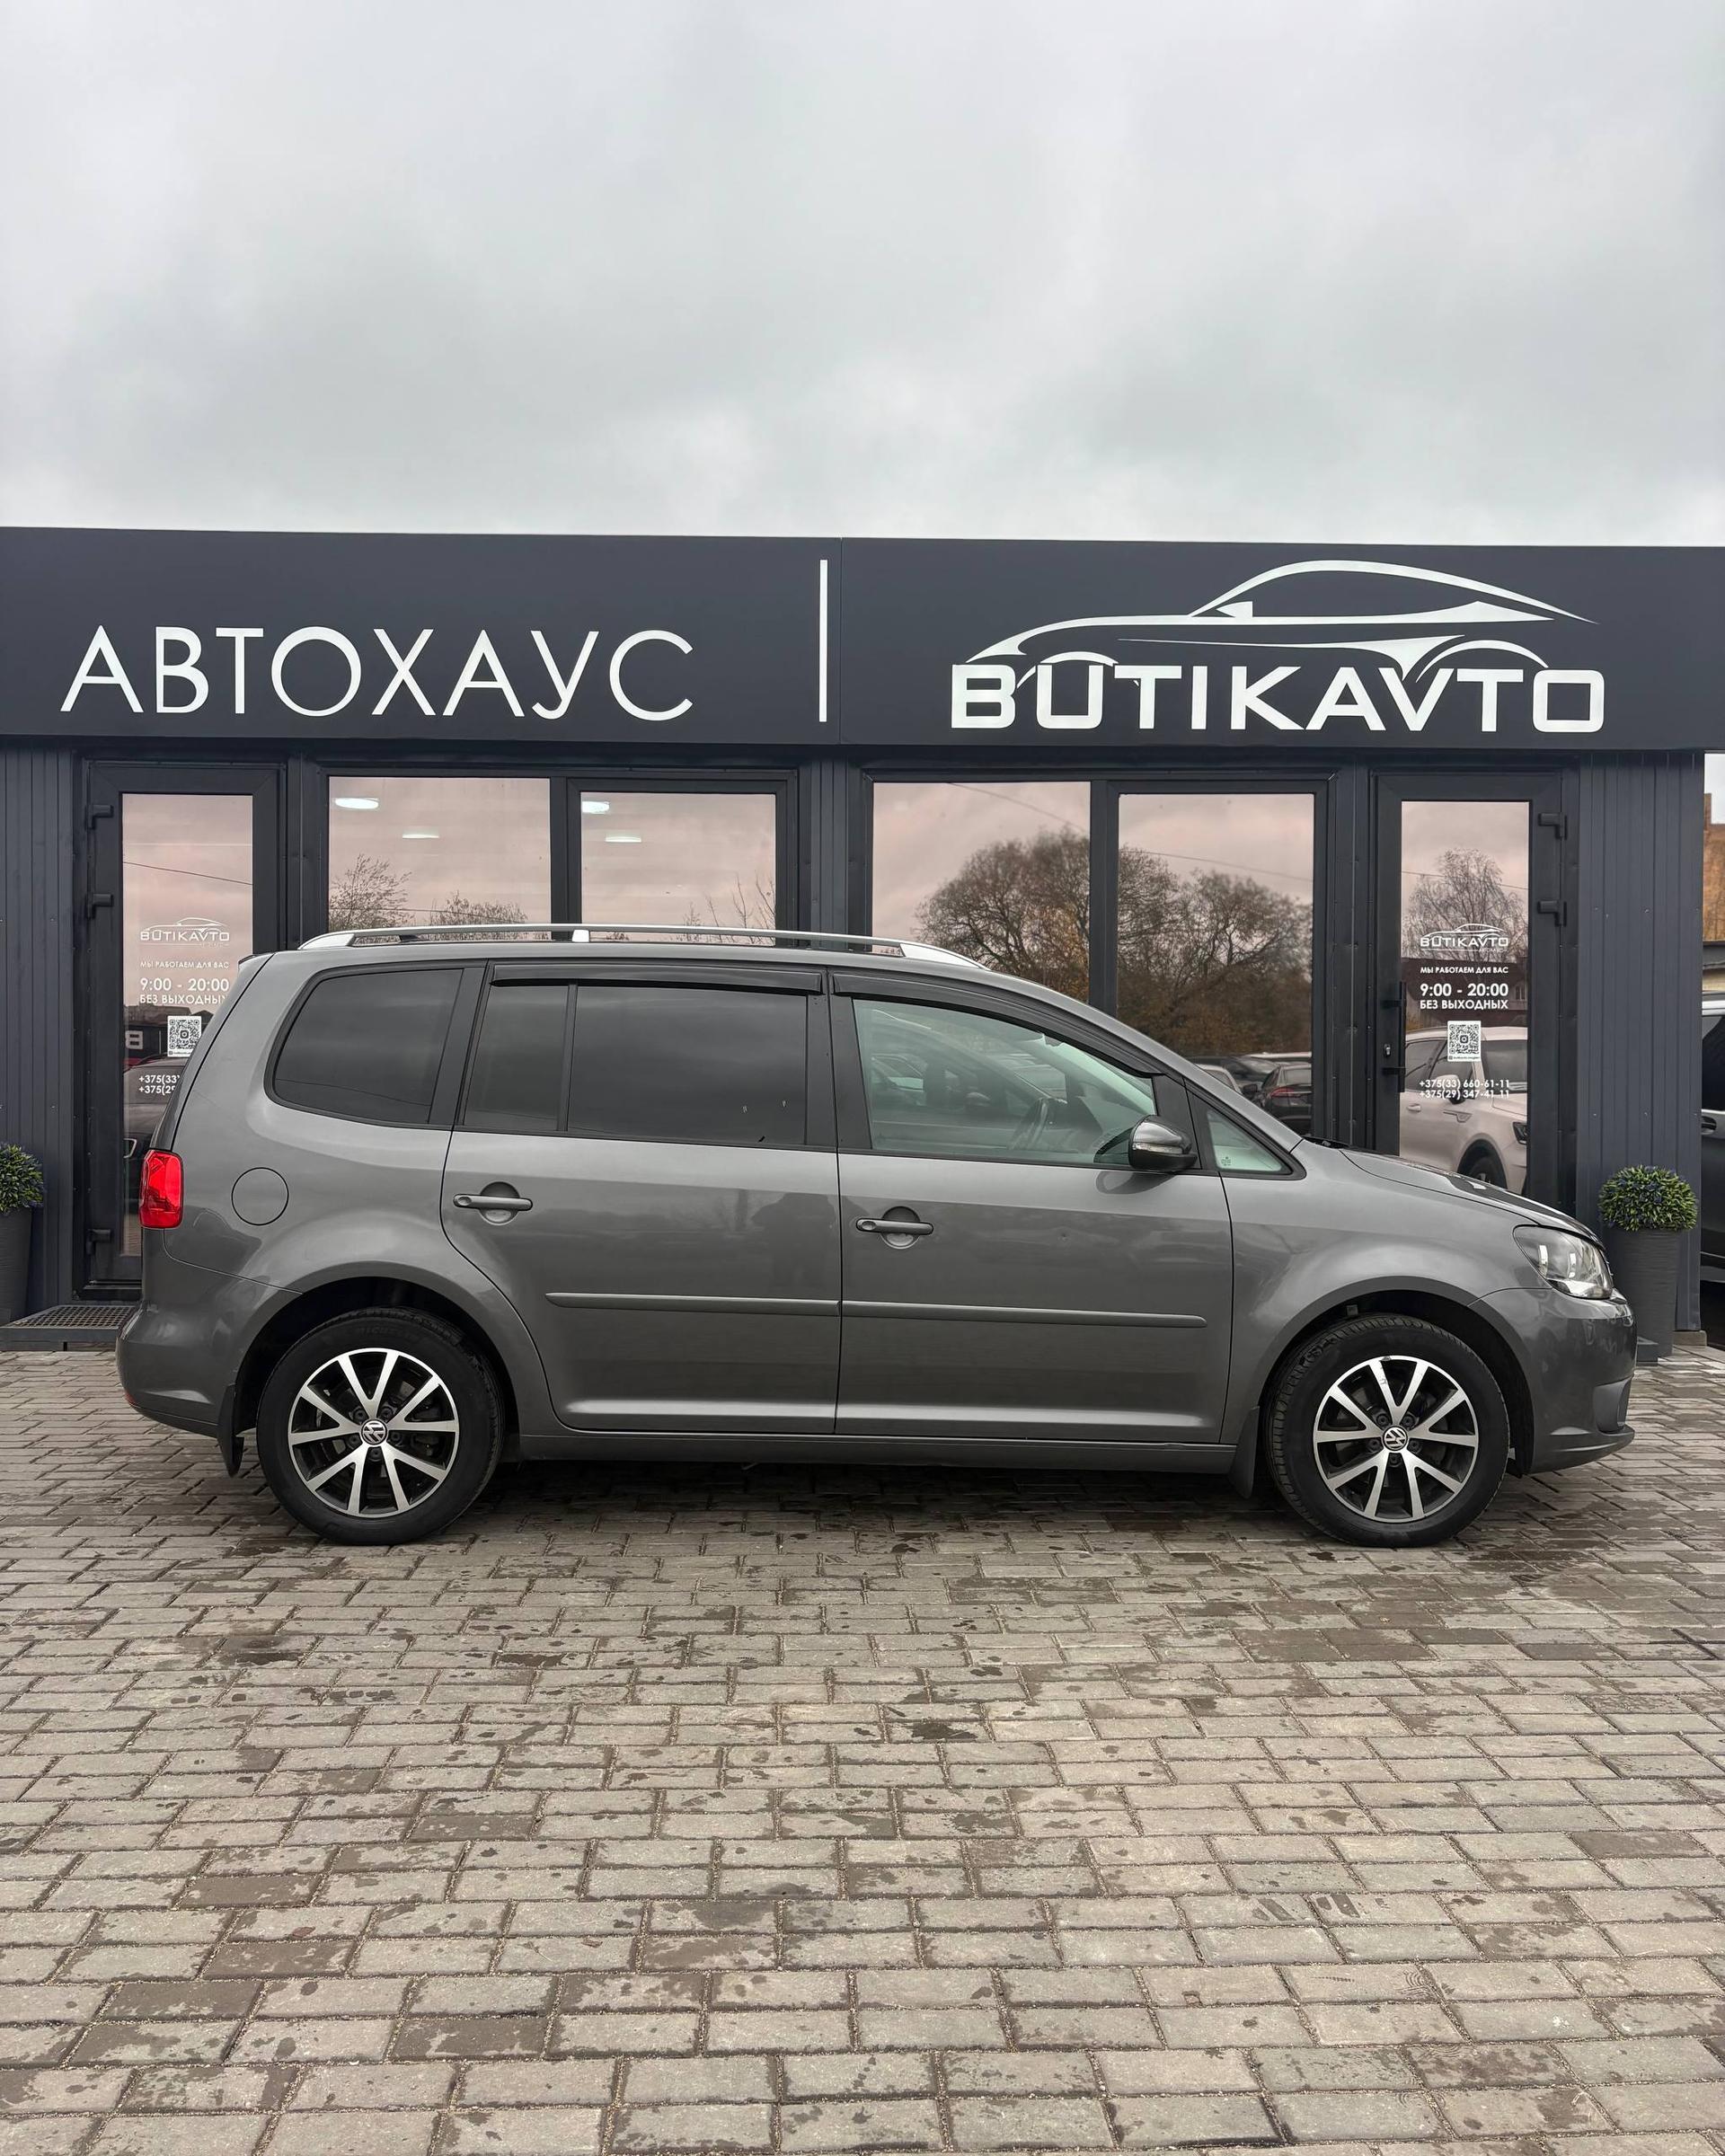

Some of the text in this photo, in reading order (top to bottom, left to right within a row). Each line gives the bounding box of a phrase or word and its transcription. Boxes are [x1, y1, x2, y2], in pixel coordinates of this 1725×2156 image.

[60, 625, 694, 720] АВТОХАУС
[951, 664, 1605, 733] BUTIKAVTO
[140, 931, 230, 941] BUTIKAVTO
[1420, 937, 1509, 948] BUTIKAVTO
[197, 961, 212, 969] ДЛЯ
[140, 977, 172, 991] 9:00
[188, 978, 230, 992] 20:00
[1420, 983, 1452, 996] 9:00
[1467, 983, 1509, 996] 20:00
[139, 994, 158, 1004] БЕЗ
[1420, 1000, 1508, 1011] БЕЗ ВЫХОДНЫХ
[1420, 1079, 1509, 1089] +375(33) 660-61-11
[1463, 1090, 1509, 1099] 347-4111
